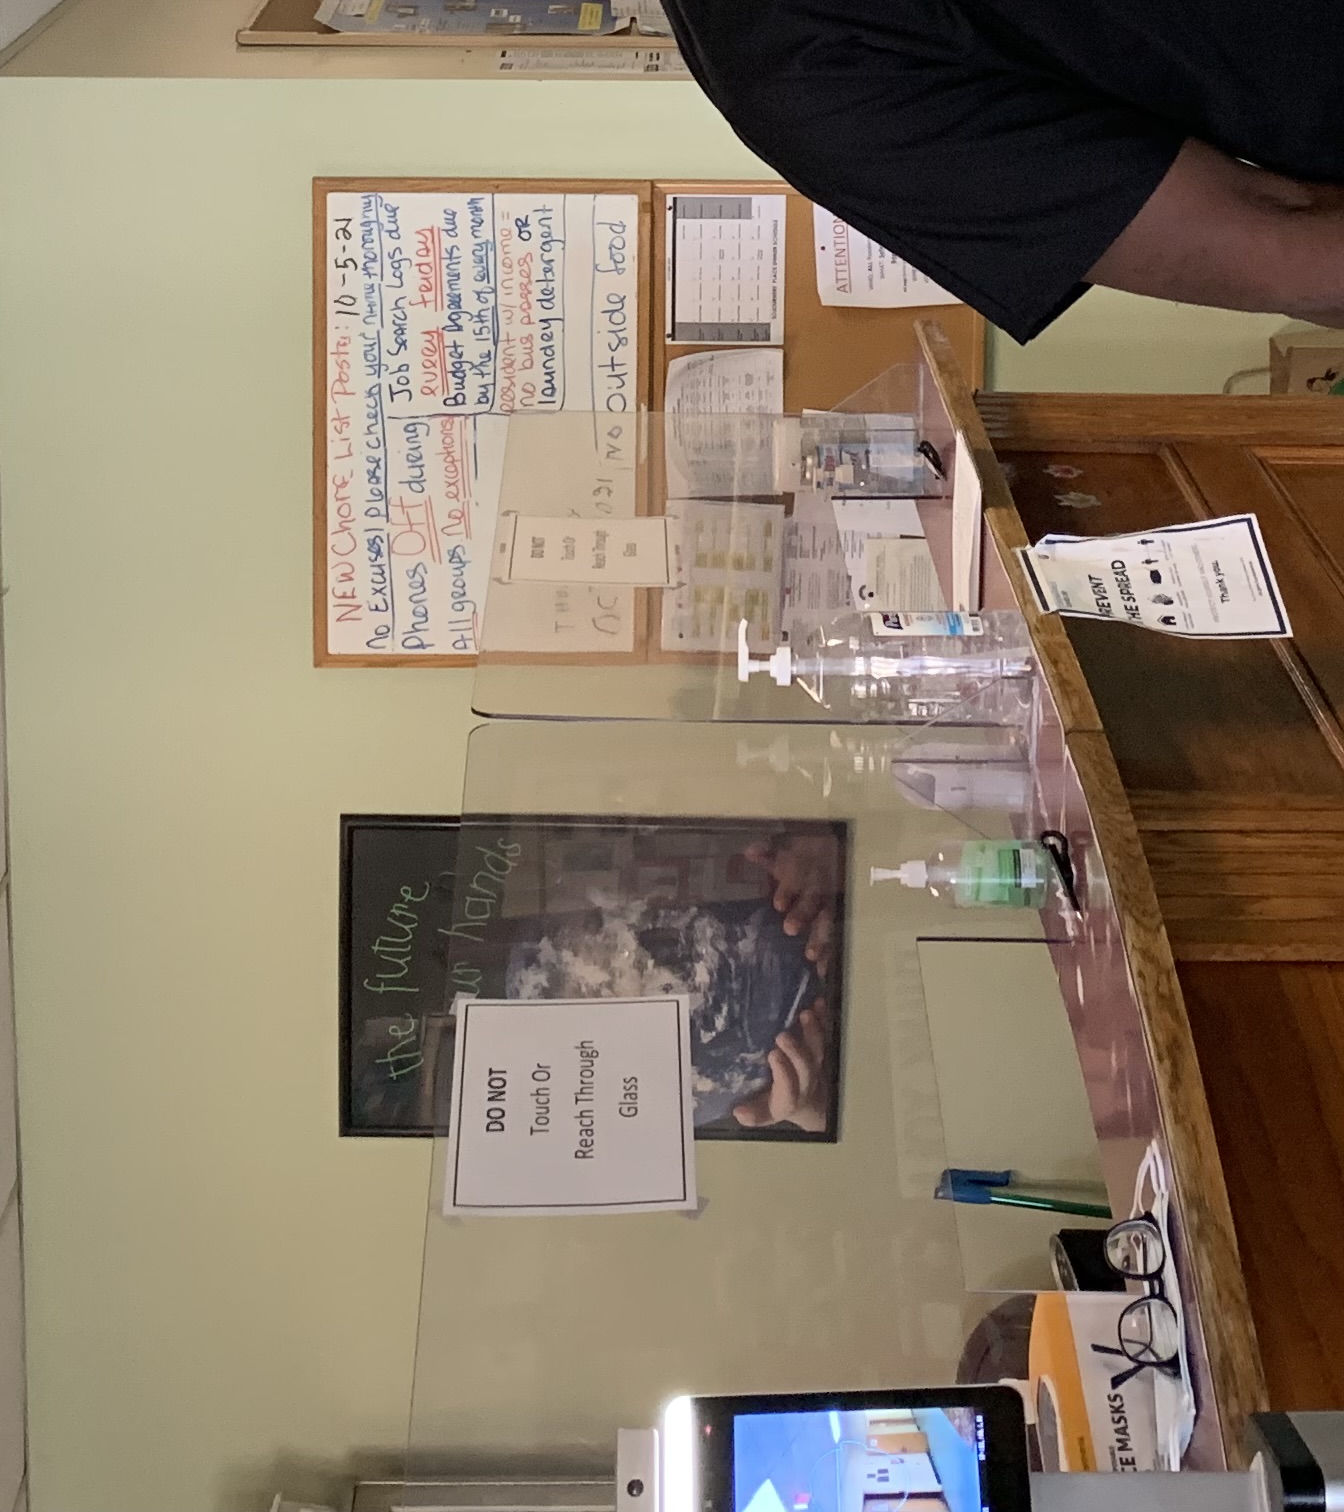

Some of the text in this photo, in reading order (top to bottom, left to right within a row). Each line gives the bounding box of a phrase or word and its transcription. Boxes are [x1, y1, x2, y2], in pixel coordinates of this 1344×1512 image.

[383, 202, 401, 240] due
[499, 227, 514, 296] income
[532, 204, 563, 311] detergent
[471, 286, 495, 304] of
[518, 251, 535, 326] passes
[442, 340, 474, 407] Budget
[469, 349, 491, 378] the
[518, 333, 534, 371] bus
[387, 363, 412, 403] Job
[473, 383, 495, 405] by
[333, 408, 354, 459] List
[331, 561, 362, 622] NEW
[1110, 559, 1137, 603] SPREAD
[1214, 578, 1231, 604] Thank
[436, 836, 522, 942] hands
[362, 880, 431, 1080] the future
[485, 1067, 507, 1133] DO NOT
[529, 1063, 551, 1136] Touch Or
[573, 1040, 599, 1160] Reach Through
[618, 1076, 639, 1118] Glass
[1106, 1393, 1134, 1452] MASKS
